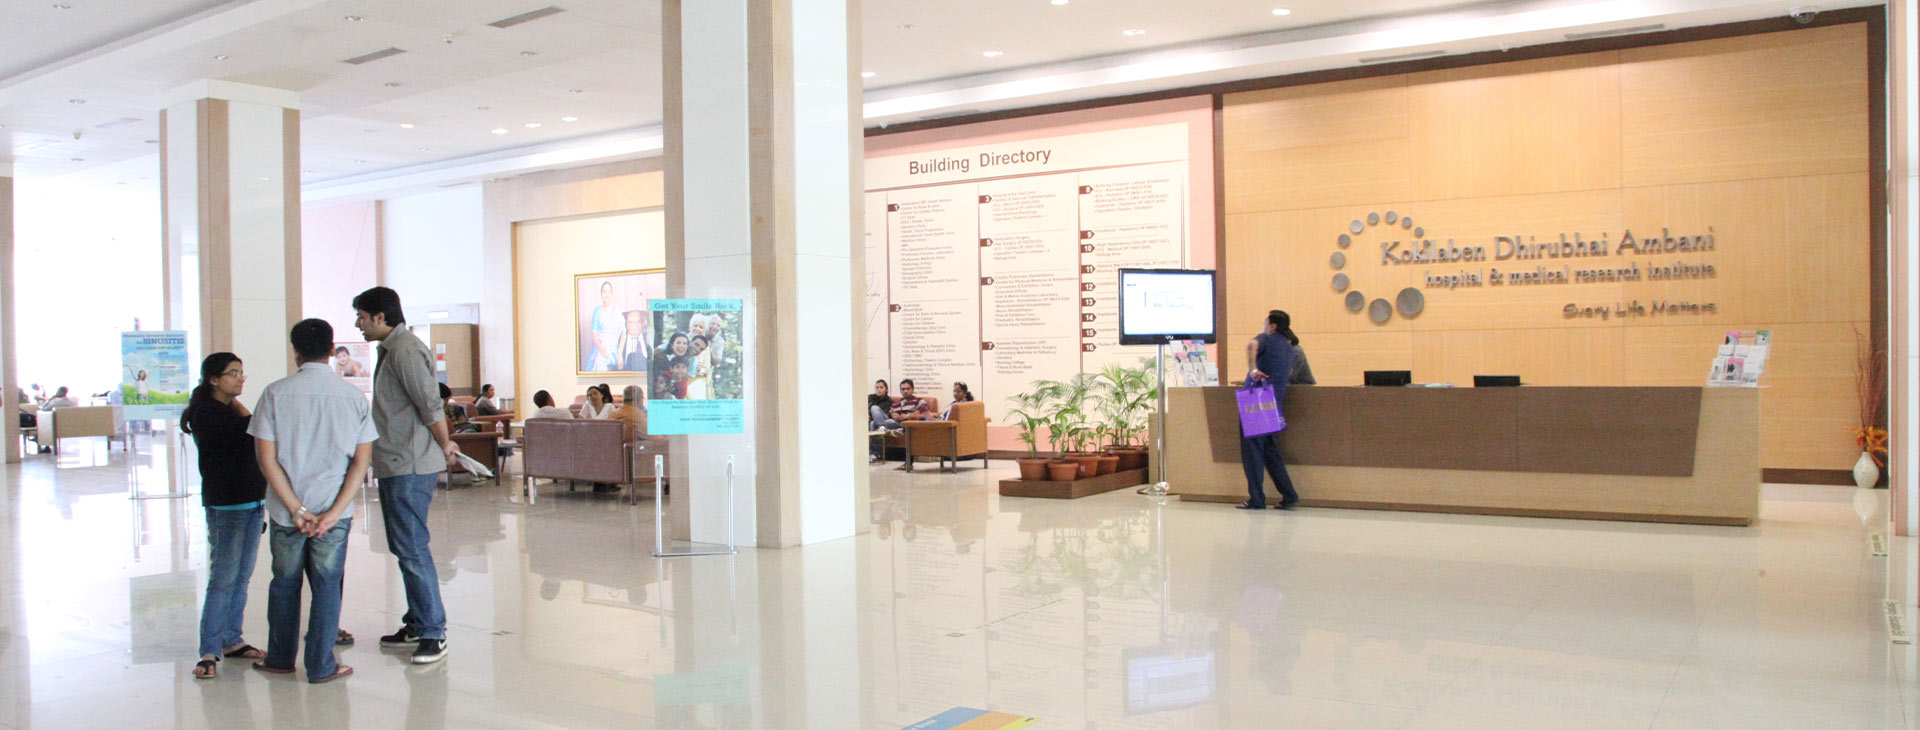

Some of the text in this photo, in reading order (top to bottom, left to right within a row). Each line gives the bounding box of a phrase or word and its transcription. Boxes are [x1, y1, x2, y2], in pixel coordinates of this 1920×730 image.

[909, 149, 1051, 175] Building Directory
[1381, 226, 1715, 267] Kokilaben Dhirubhai Ambani
[1425, 260, 1715, 290] hospital & medical research institute
[1563, 299, 1717, 320] Every Life Matters
